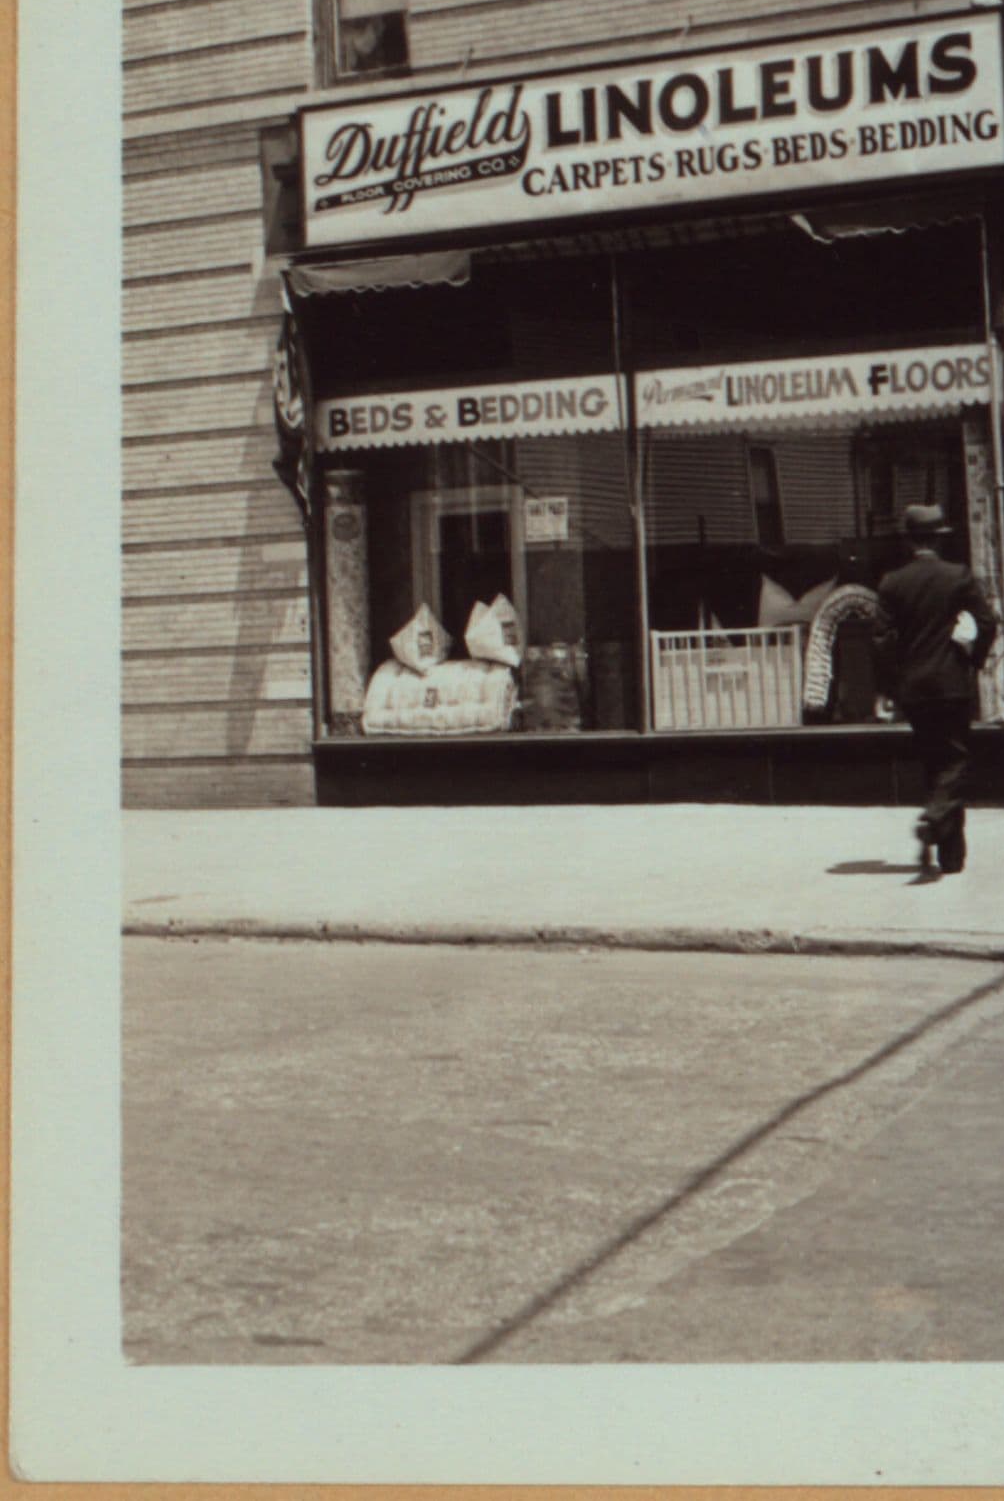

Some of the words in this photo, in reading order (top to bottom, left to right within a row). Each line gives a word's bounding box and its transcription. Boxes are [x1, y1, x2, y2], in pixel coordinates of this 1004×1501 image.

[546, 32, 978, 150] LINOLEUMS
[314, 83, 525, 215] Duffield
[392, 165, 472, 194] COVERING
[522, 154, 665, 197] CARPETS
[675, 140, 763, 179] RUGS
[772, 128, 848, 166] BEDS
[858, 109, 999, 156] BEDDING
[329, 402, 413, 438] BEDS
[424, 404, 448, 429] &
[457, 387, 609, 428] BEDDING
[726, 366, 858, 407] LINOLEUM
[867, 355, 991, 396] FLOORS
